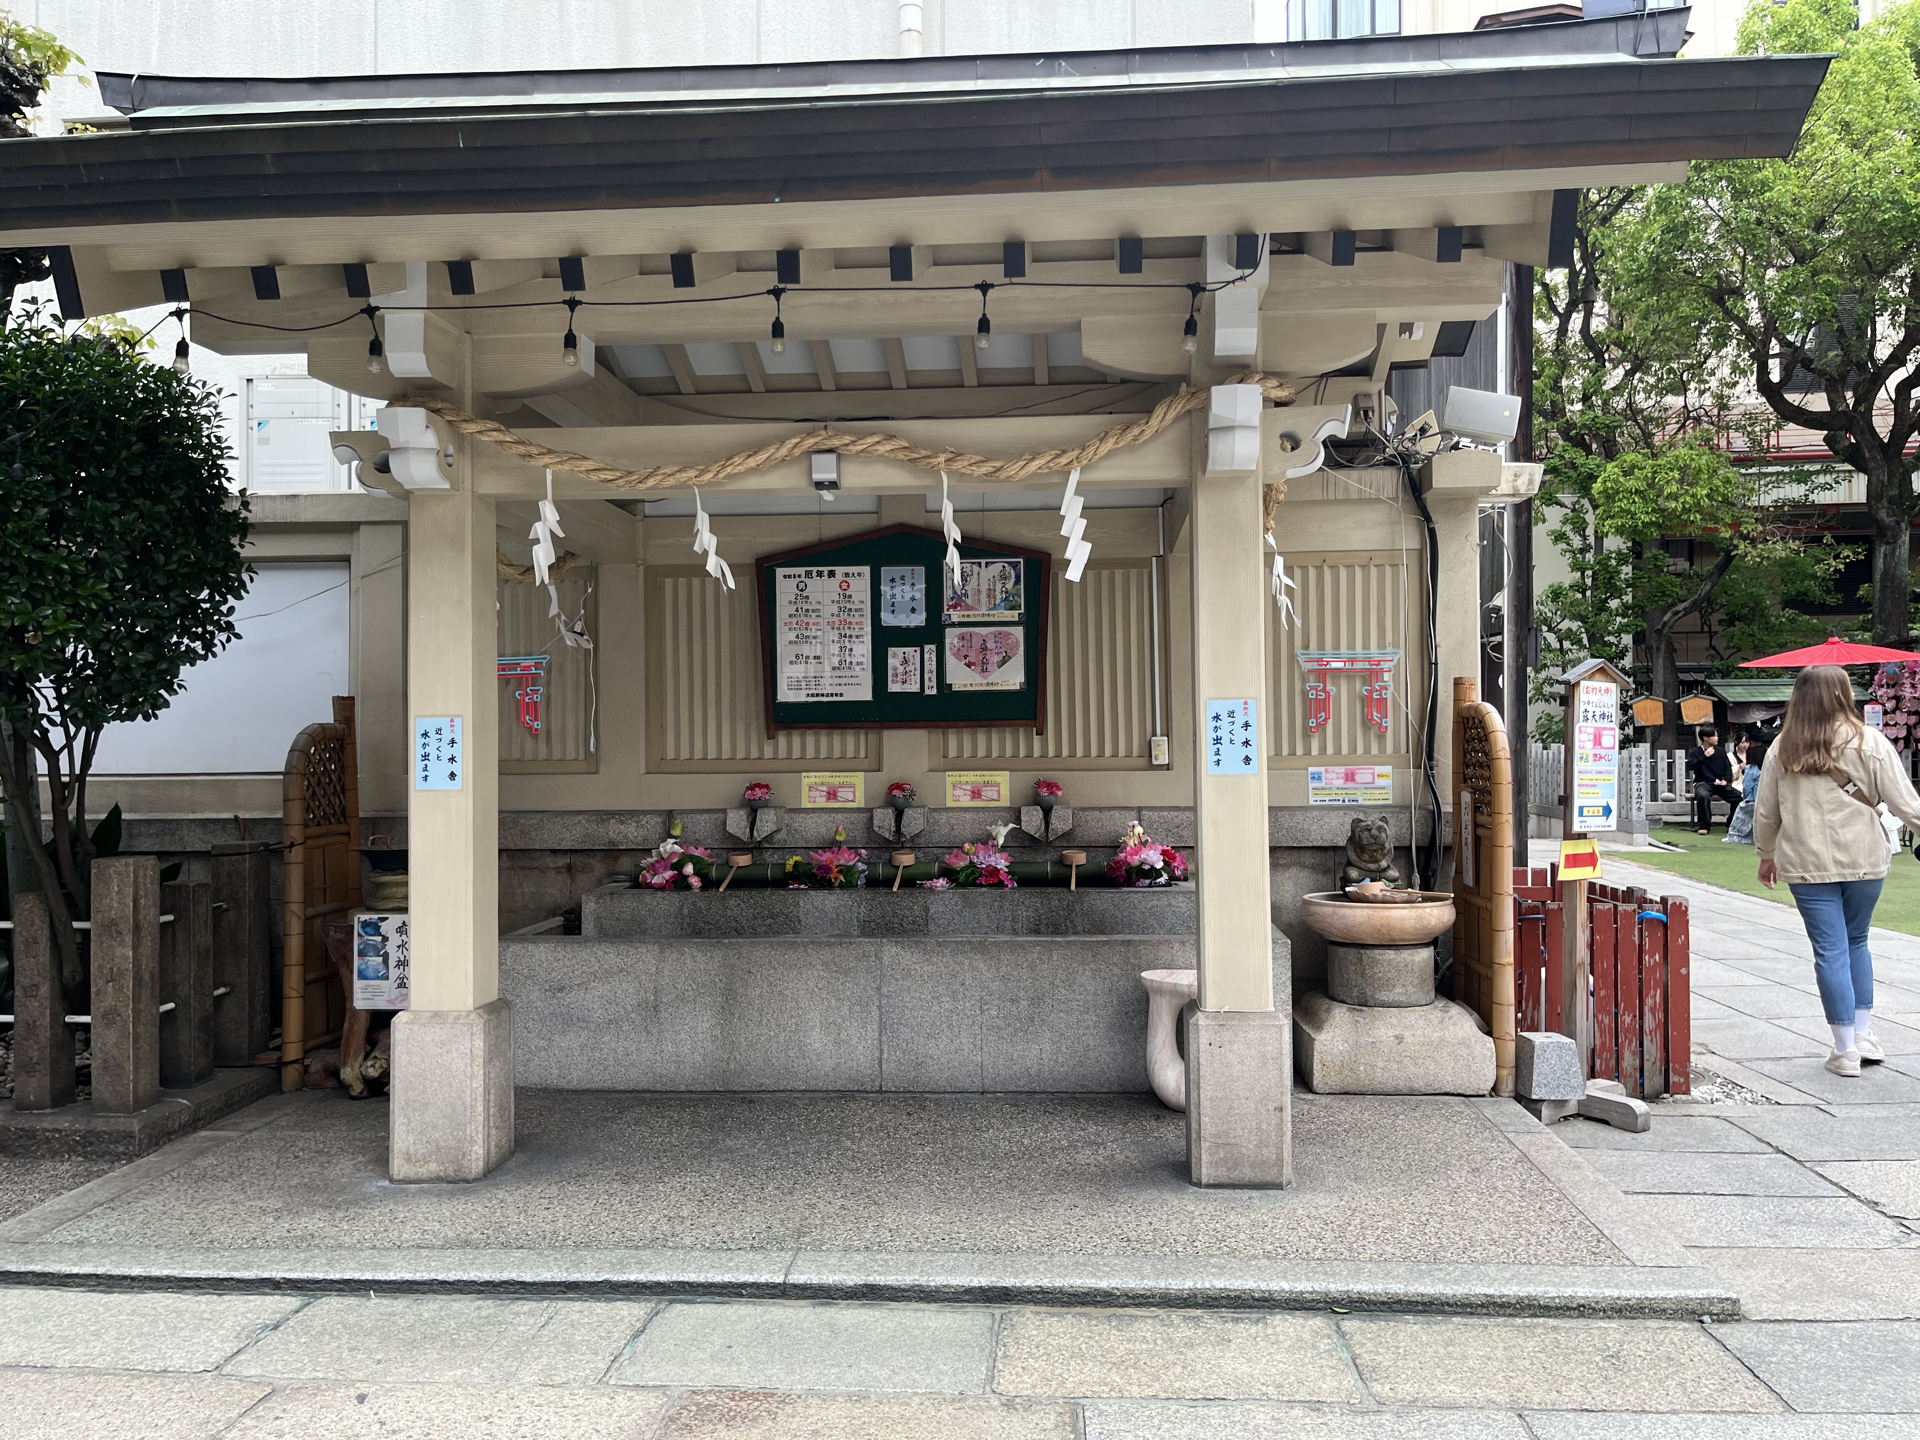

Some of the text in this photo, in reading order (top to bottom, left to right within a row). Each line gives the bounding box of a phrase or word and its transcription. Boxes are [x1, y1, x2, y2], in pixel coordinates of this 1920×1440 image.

[804, 570, 836, 579] 厄年表
[837, 592, 852, 600] 19歳
[888, 576, 897, 615] 水が出ます
[1582, 685, 1612, 696] （お初天神）
[1582, 700, 1614, 709] つゆてんじんしゃ
[1227, 709, 1236, 745] 近づくと
[1582, 708, 1614, 723] 露天神社
[420, 729, 431, 783] 水が出ます
[435, 727, 443, 762] 近づくと
[1212, 712, 1223, 768] 水が出ます
[1241, 720, 1252, 766] 手水舎
[1592, 753, 1613, 762] 恋みくじ
[447, 737, 458, 782] 手水舎
[393, 920, 409, 989] 噴水神盆
